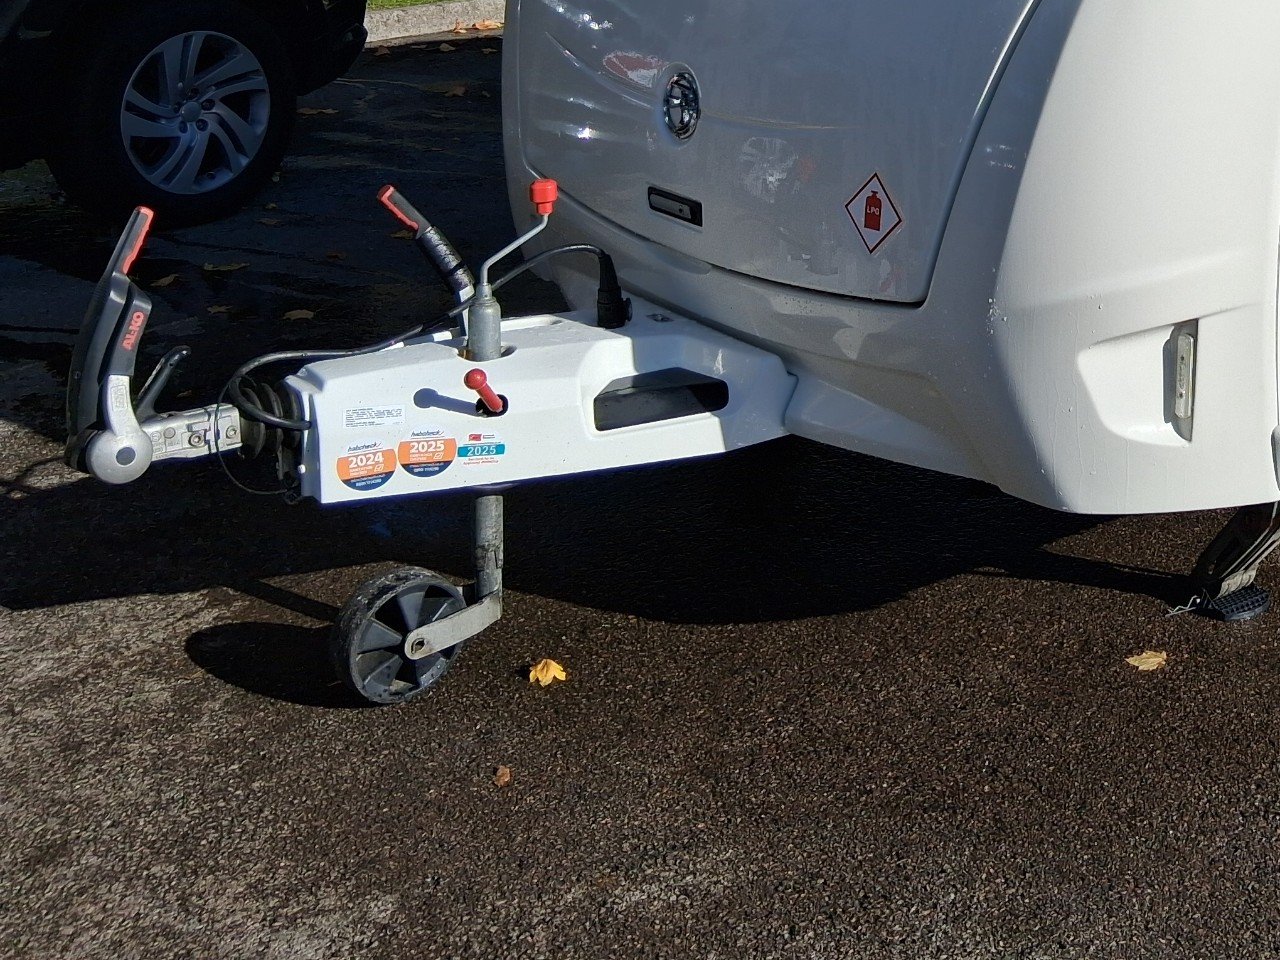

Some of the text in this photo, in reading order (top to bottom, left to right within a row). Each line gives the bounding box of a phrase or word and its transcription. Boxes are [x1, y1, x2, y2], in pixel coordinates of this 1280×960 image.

[409, 440, 445, 454] 2025
[467, 445, 496, 456] 2025
[348, 451, 384, 469] 2024
